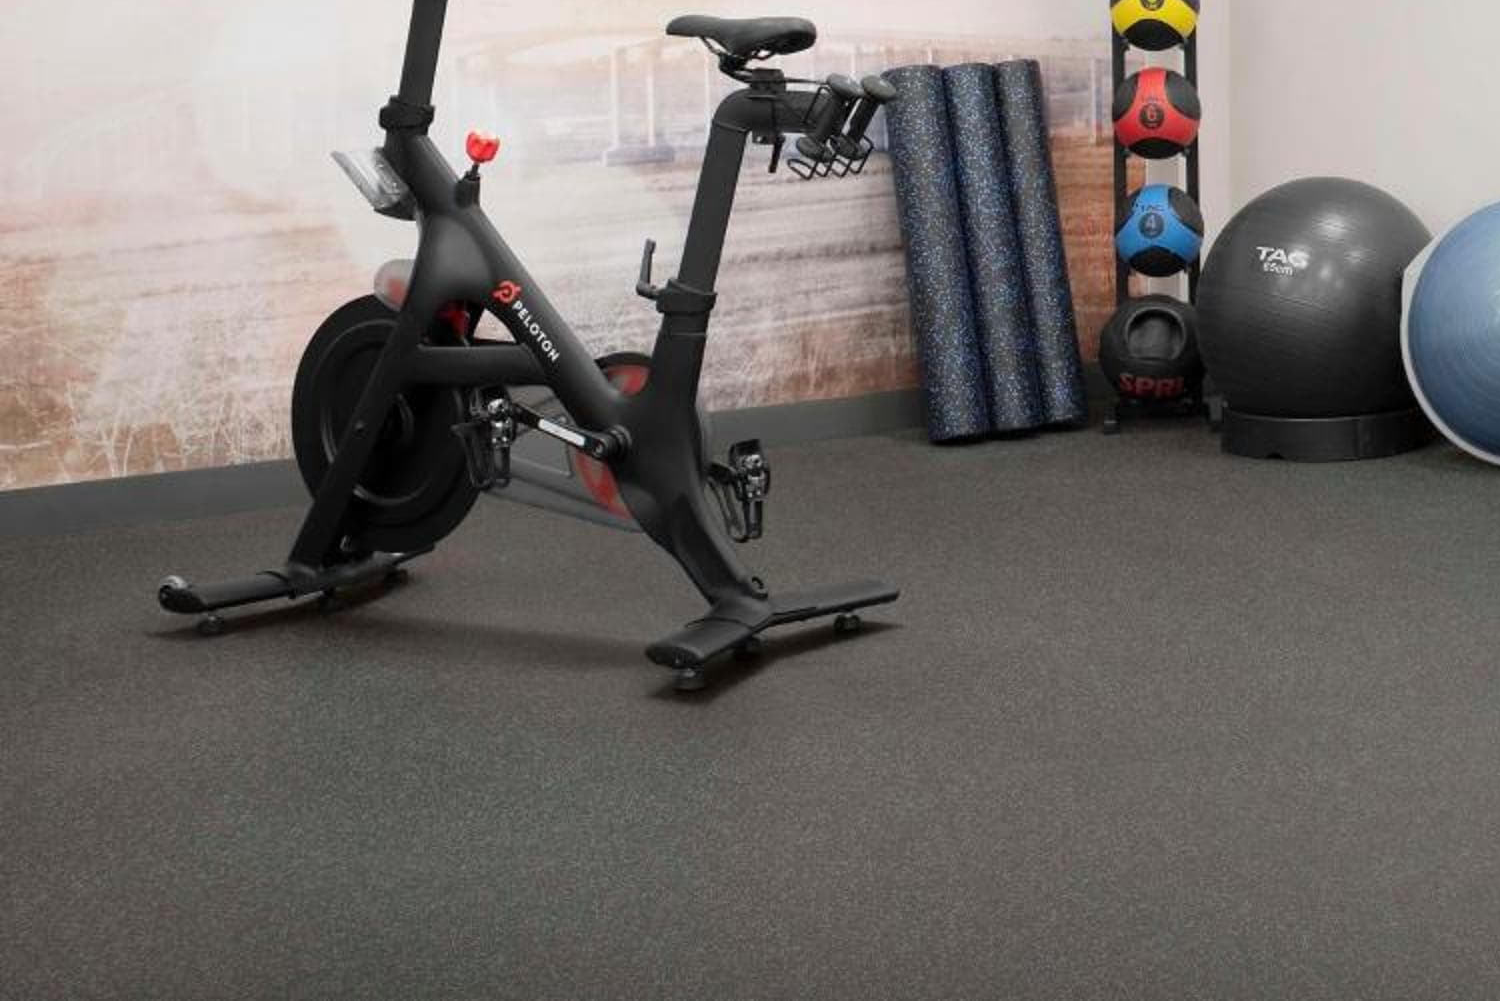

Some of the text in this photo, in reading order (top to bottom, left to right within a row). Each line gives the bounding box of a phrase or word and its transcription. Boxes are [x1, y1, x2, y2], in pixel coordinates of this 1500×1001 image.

[1145, 214, 1157, 230] 4
[1256, 246, 1310, 270] TAG
[511, 300, 560, 362] PELOTON
[1119, 373, 1185, 398] SPRI
